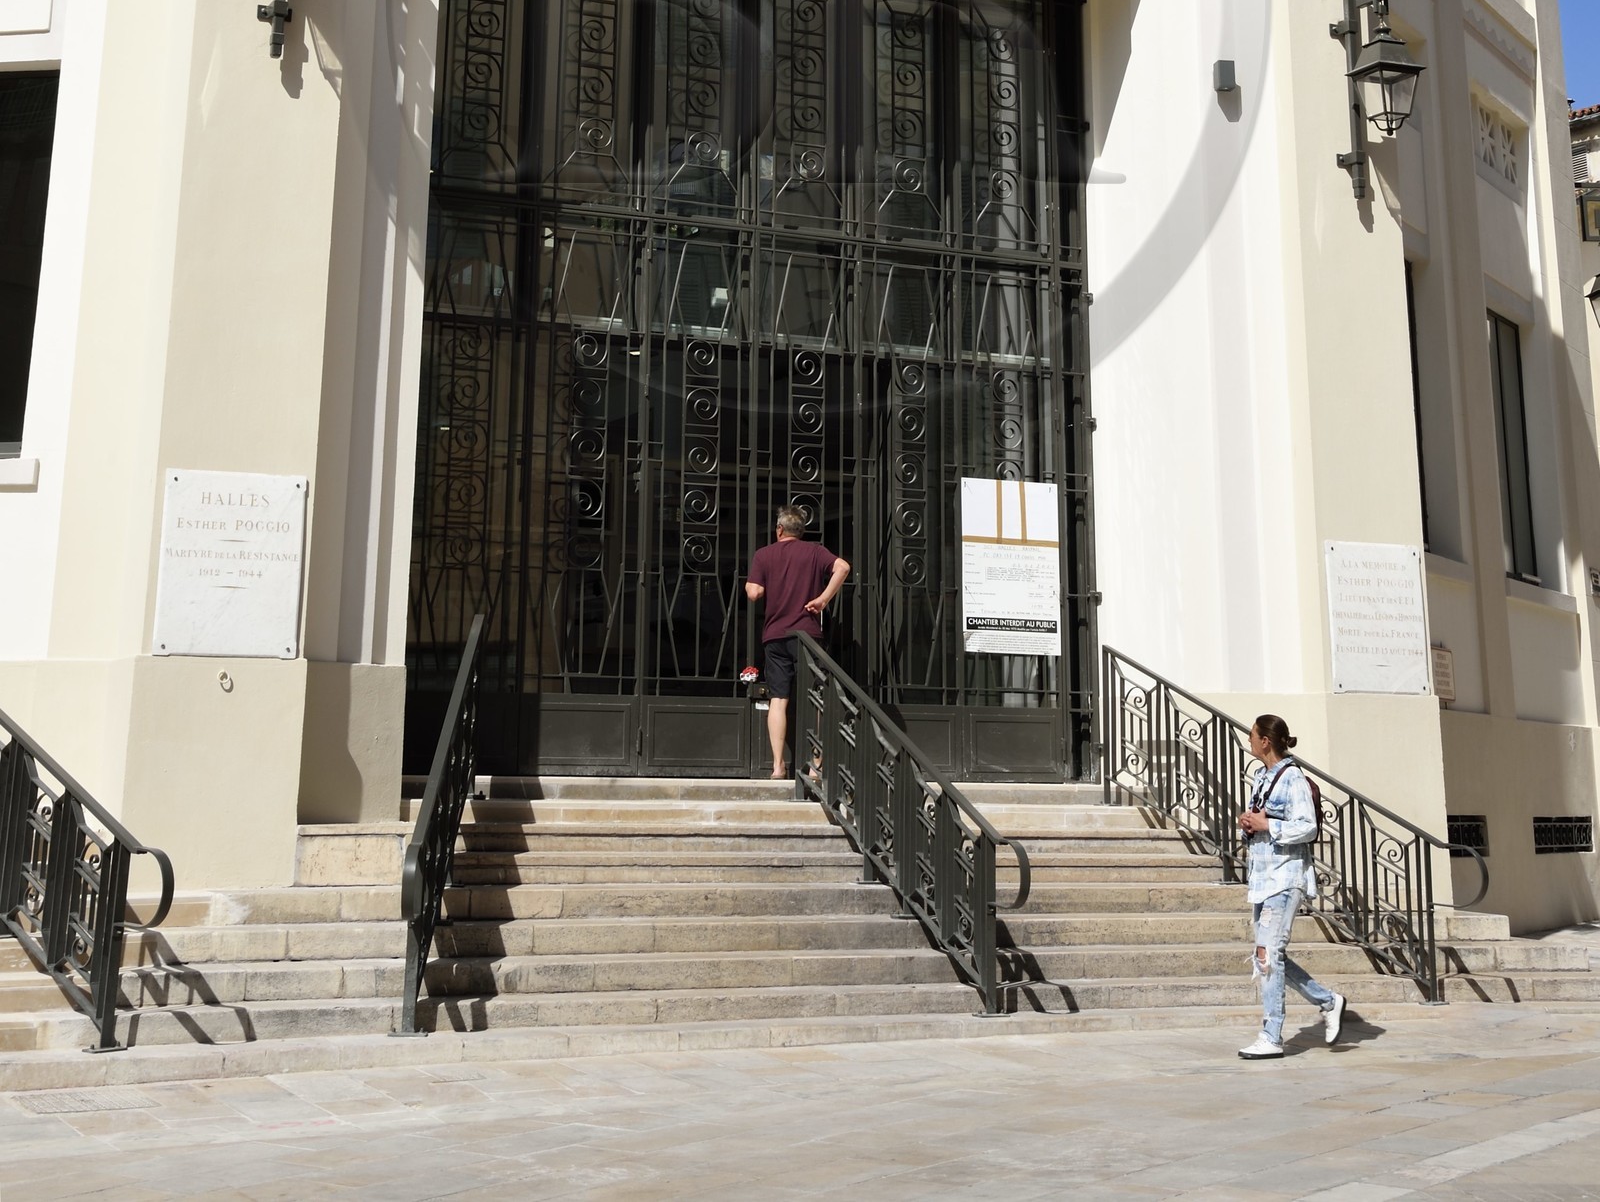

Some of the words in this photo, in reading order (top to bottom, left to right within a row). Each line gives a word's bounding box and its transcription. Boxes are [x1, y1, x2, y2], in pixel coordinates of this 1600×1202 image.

[201, 491, 271, 508] HALLES
[177, 517, 227, 531] ESTHER
[235, 519, 290, 533] POGGIO
[165, 547, 213, 559] MARTYRE
[238, 569, 263, 578] 1944
[1337, 576, 1371, 587] ESTHER
[1377, 578, 1415, 589] POGGIO
[968, 618, 998, 626] CHANTIER
[999, 619, 1025, 627] INTERDIT
[1026, 620, 1035, 628] AU
[1036, 621, 1056, 629] PUBLIC
